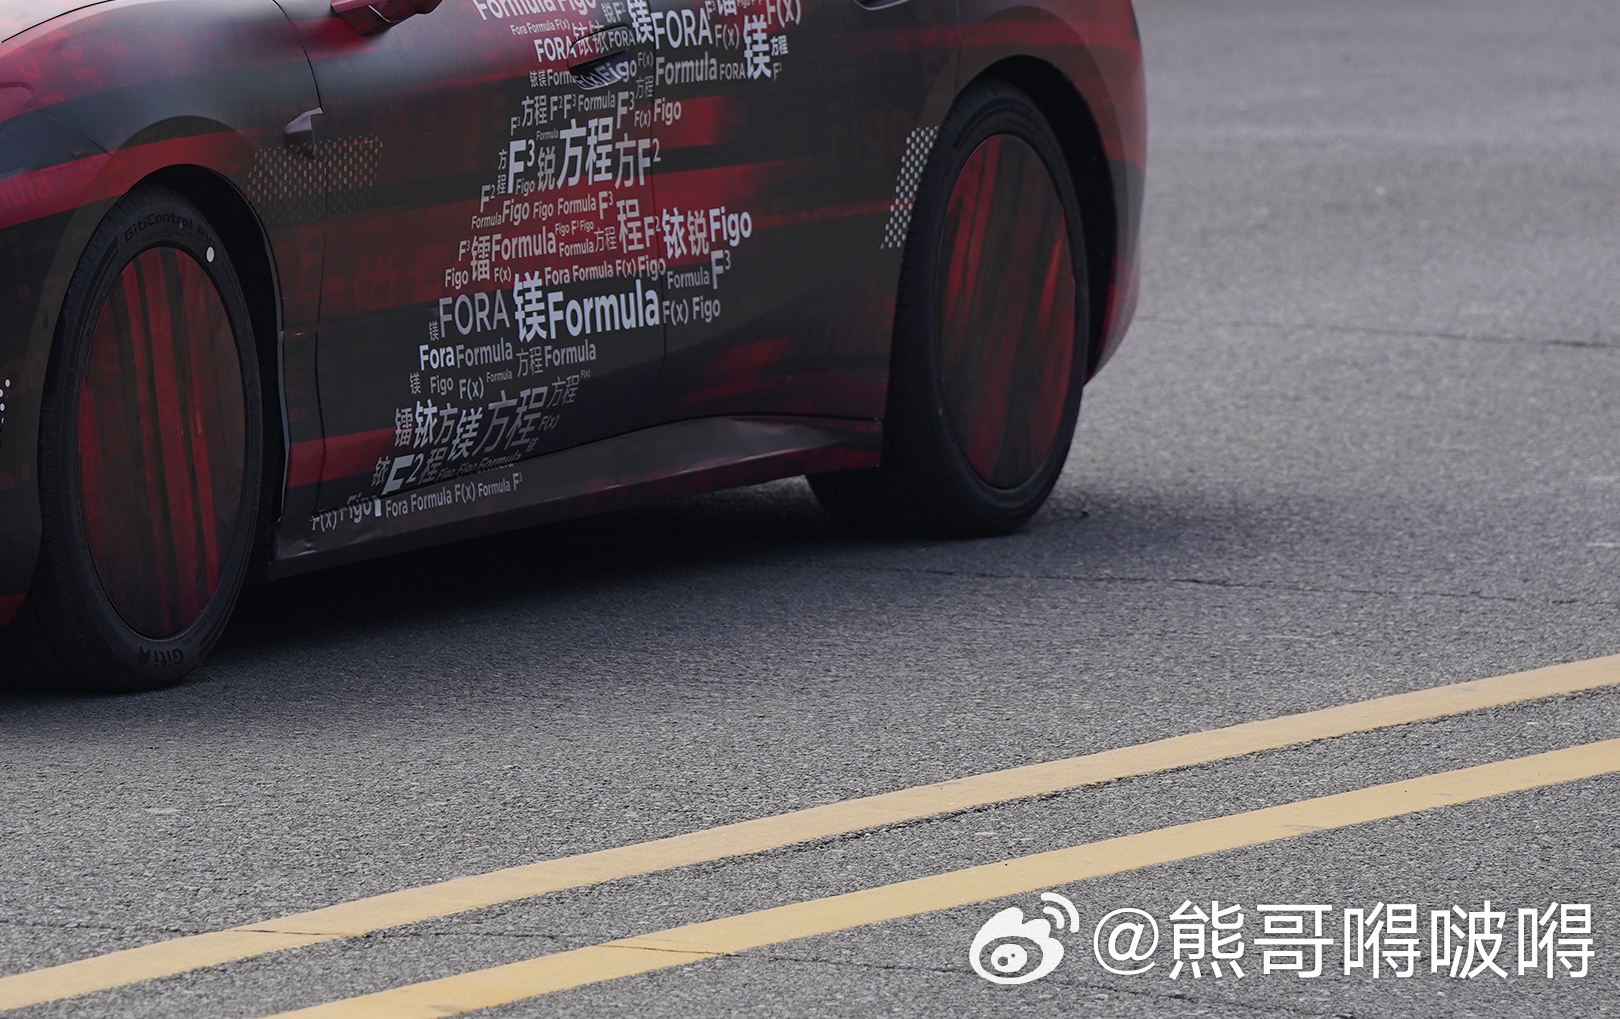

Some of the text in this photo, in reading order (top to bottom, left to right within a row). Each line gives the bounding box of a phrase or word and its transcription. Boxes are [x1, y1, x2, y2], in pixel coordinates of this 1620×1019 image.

[650, 8, 713, 49] FORA
[534, 36, 577, 62] FORA
[655, 51, 746, 86] Formula FORA
[578, 90, 616, 112] Formula
[654, 97, 682, 125] Figo
[515, 178, 535, 197] Figo
[471, 212, 502, 229] Formula
[502, 198, 530, 225] Figo
[533, 201, 554, 221] Figo
[558, 194, 596, 216] Formula
[709, 206, 752, 247] Figo
[491, 225, 556, 262] Formula
[558, 239, 594, 257] Formula
[445, 267, 468, 290] Figo
[544, 267, 571, 286] Fora
[572, 261, 614, 282] Formula
[637, 255, 666, 281] Figo
[667, 266, 710, 290] Formula
[438, 289, 511, 338] FORA
[547, 279, 660, 339] Formula
[692, 295, 721, 323] Figo
[419, 337, 513, 371] Fora Formula
[544, 338, 597, 368] Formula
[429, 375, 453, 397] Figo
[385, 499, 409, 518] Fora
[410, 486, 452, 512] Formula
[477, 478, 511, 497] Formula
